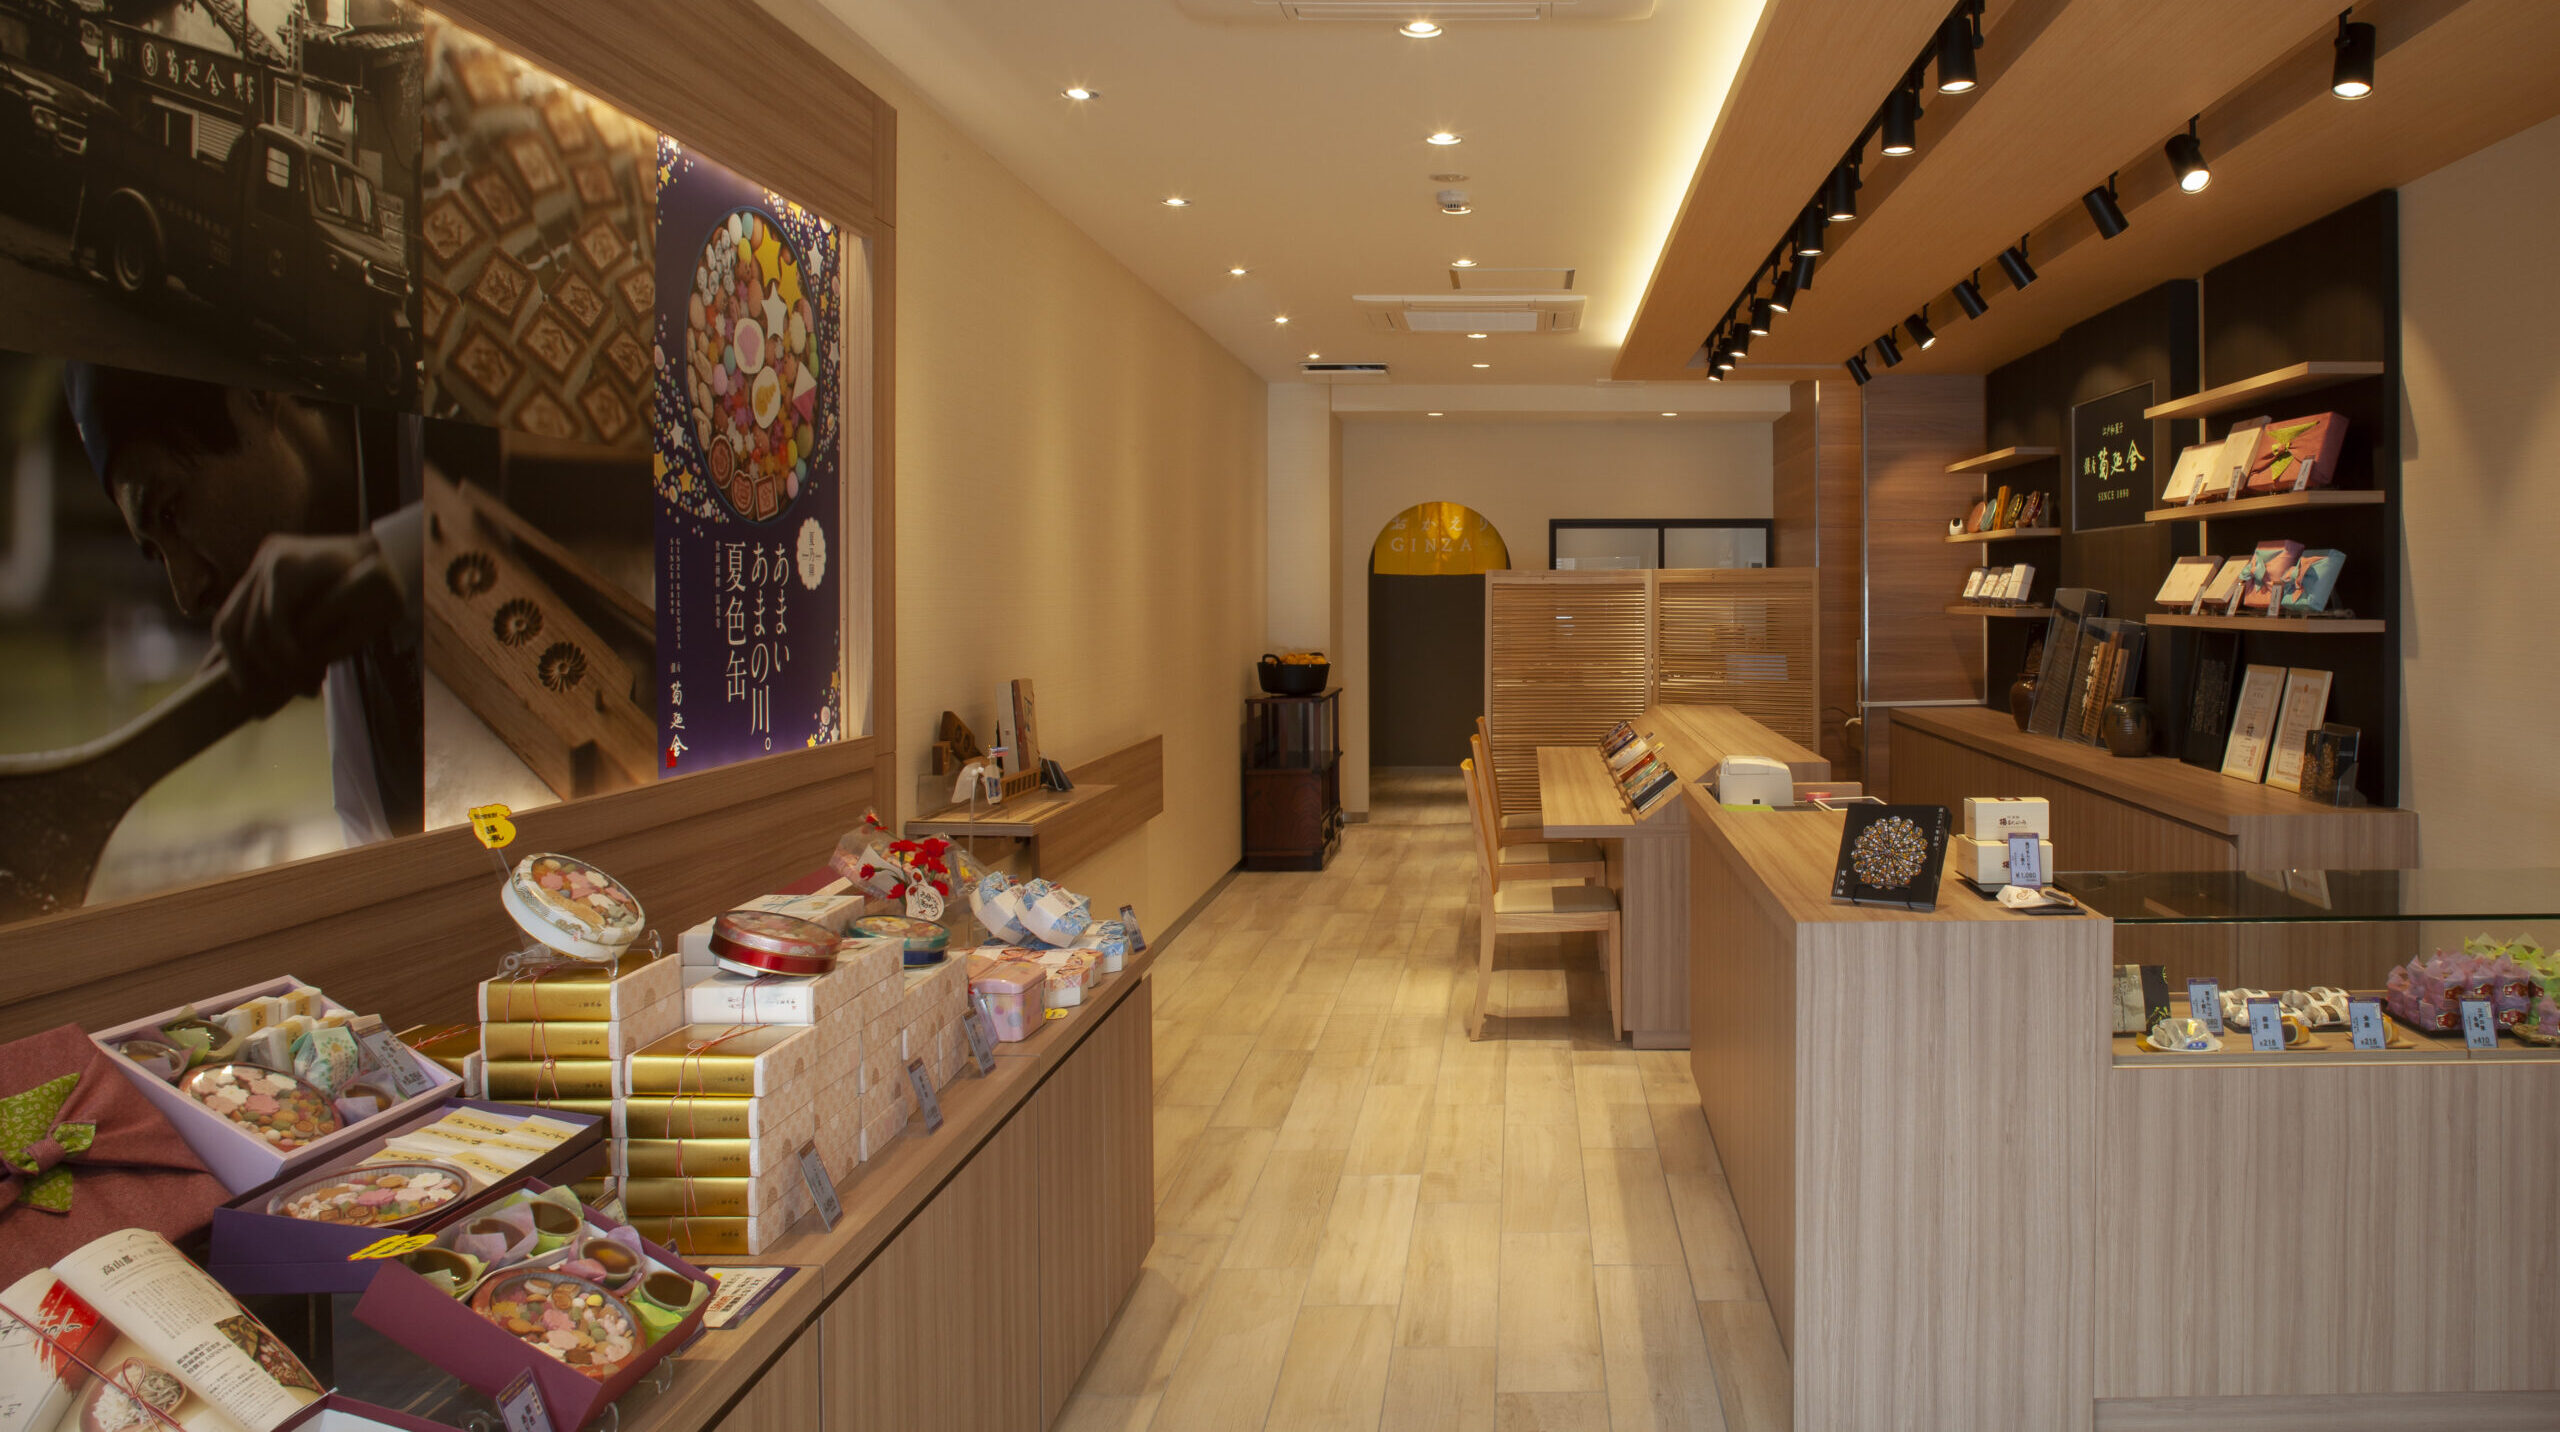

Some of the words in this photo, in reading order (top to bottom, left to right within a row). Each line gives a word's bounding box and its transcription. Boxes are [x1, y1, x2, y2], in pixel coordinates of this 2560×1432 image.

[2097, 490, 2115, 502] SINCE
[1391, 537, 1473, 553] GINZA
[724, 541, 747, 704] 夏色缶
[773, 542, 791, 673] あまい
